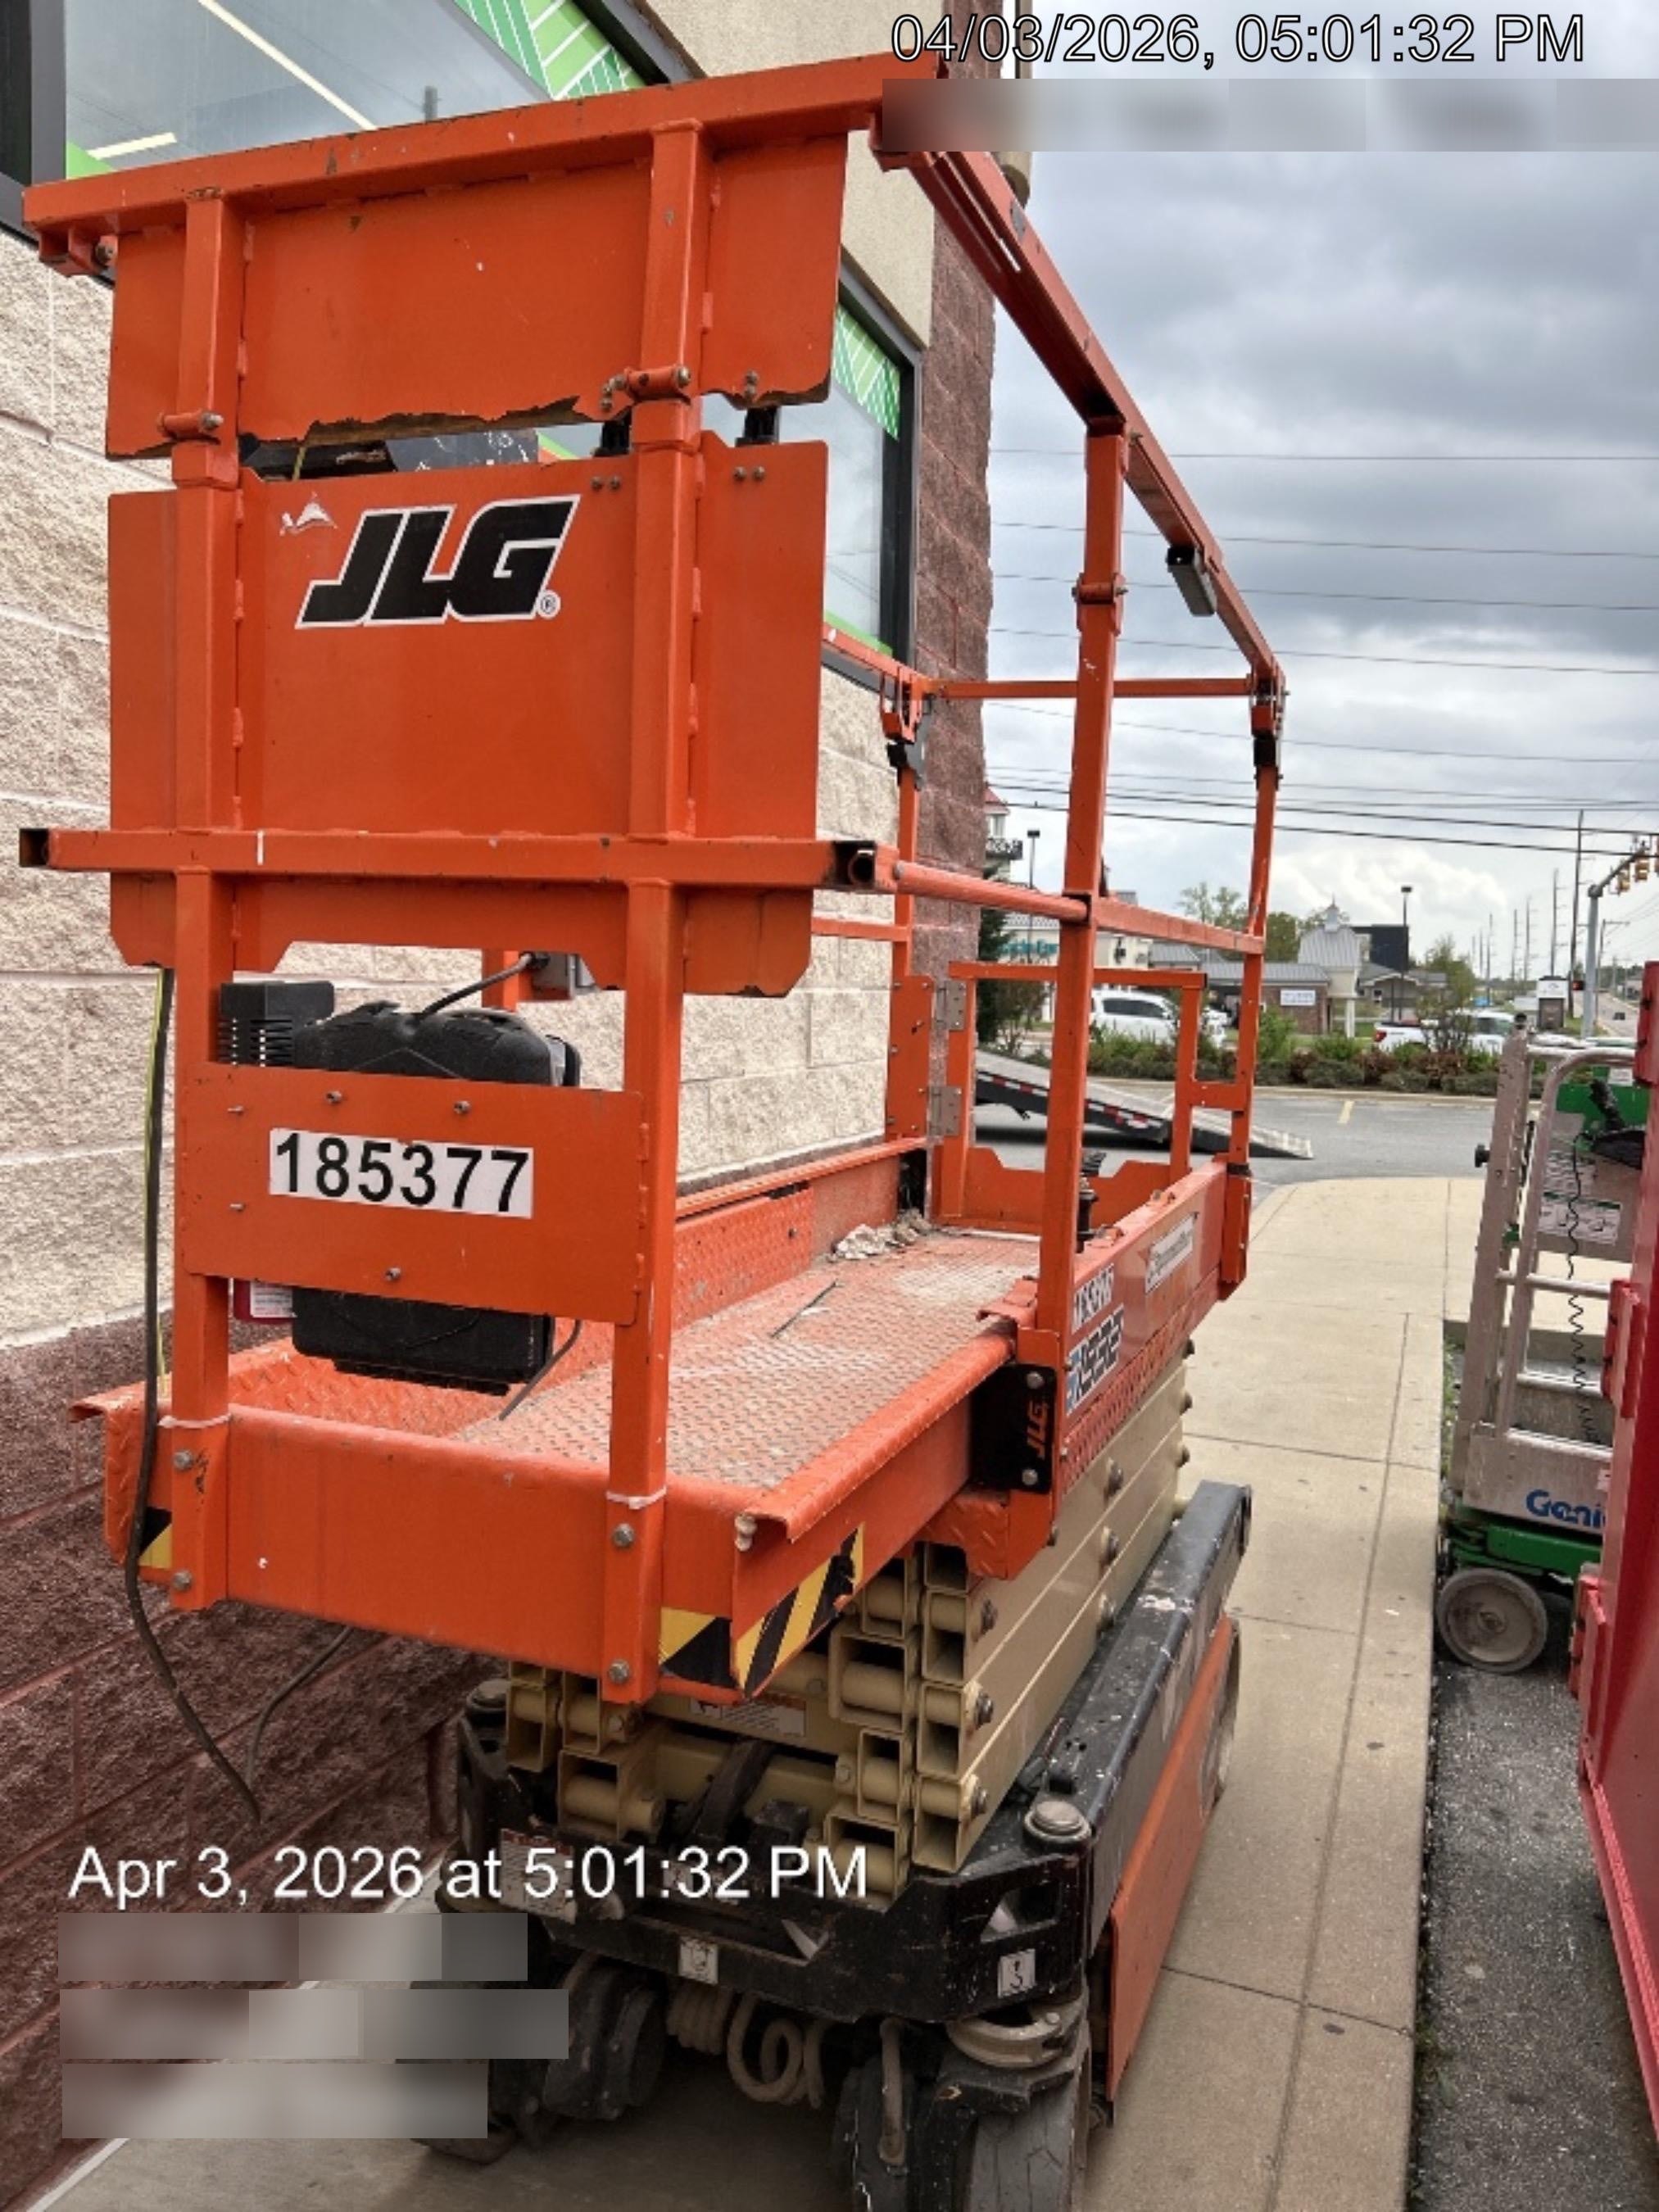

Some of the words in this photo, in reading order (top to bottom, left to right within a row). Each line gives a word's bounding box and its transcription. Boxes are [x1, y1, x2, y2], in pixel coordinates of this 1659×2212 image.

[277, 1133, 529, 1213] 185377
[1026, 1401, 1049, 1460] JLG
[1525, 1489, 1606, 1530] Geni
